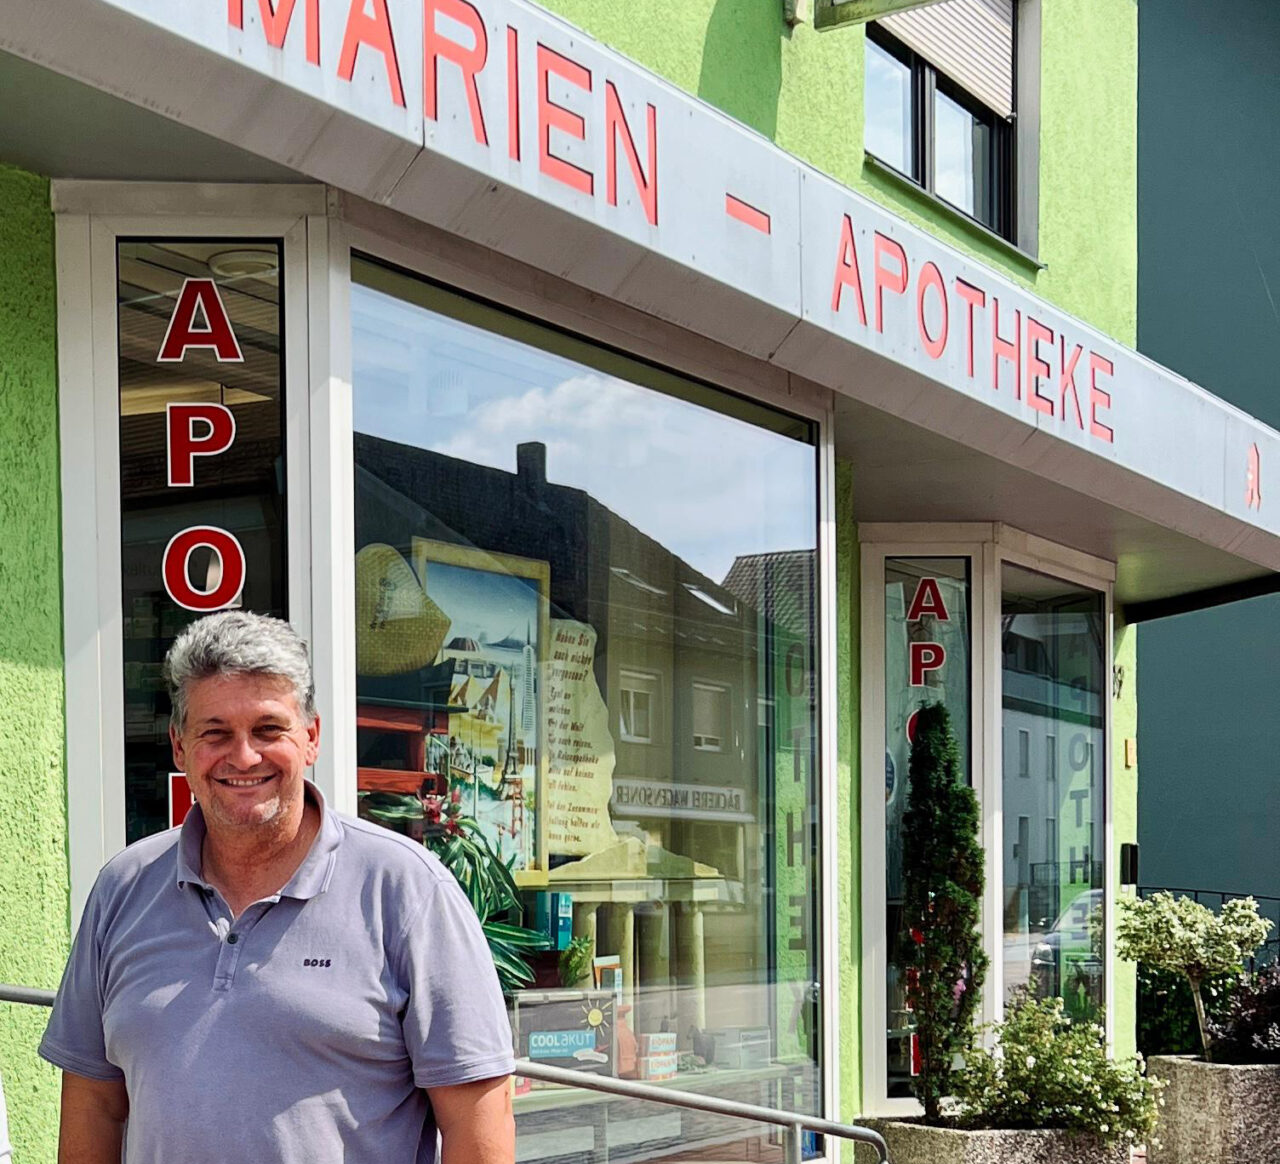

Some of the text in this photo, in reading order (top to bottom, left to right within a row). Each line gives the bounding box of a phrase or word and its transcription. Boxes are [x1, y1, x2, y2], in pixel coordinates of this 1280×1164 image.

[831, 213, 1114, 443] APOTHEKE
[157, 278, 246, 830] APO
[303, 958, 331, 968] BOSS
